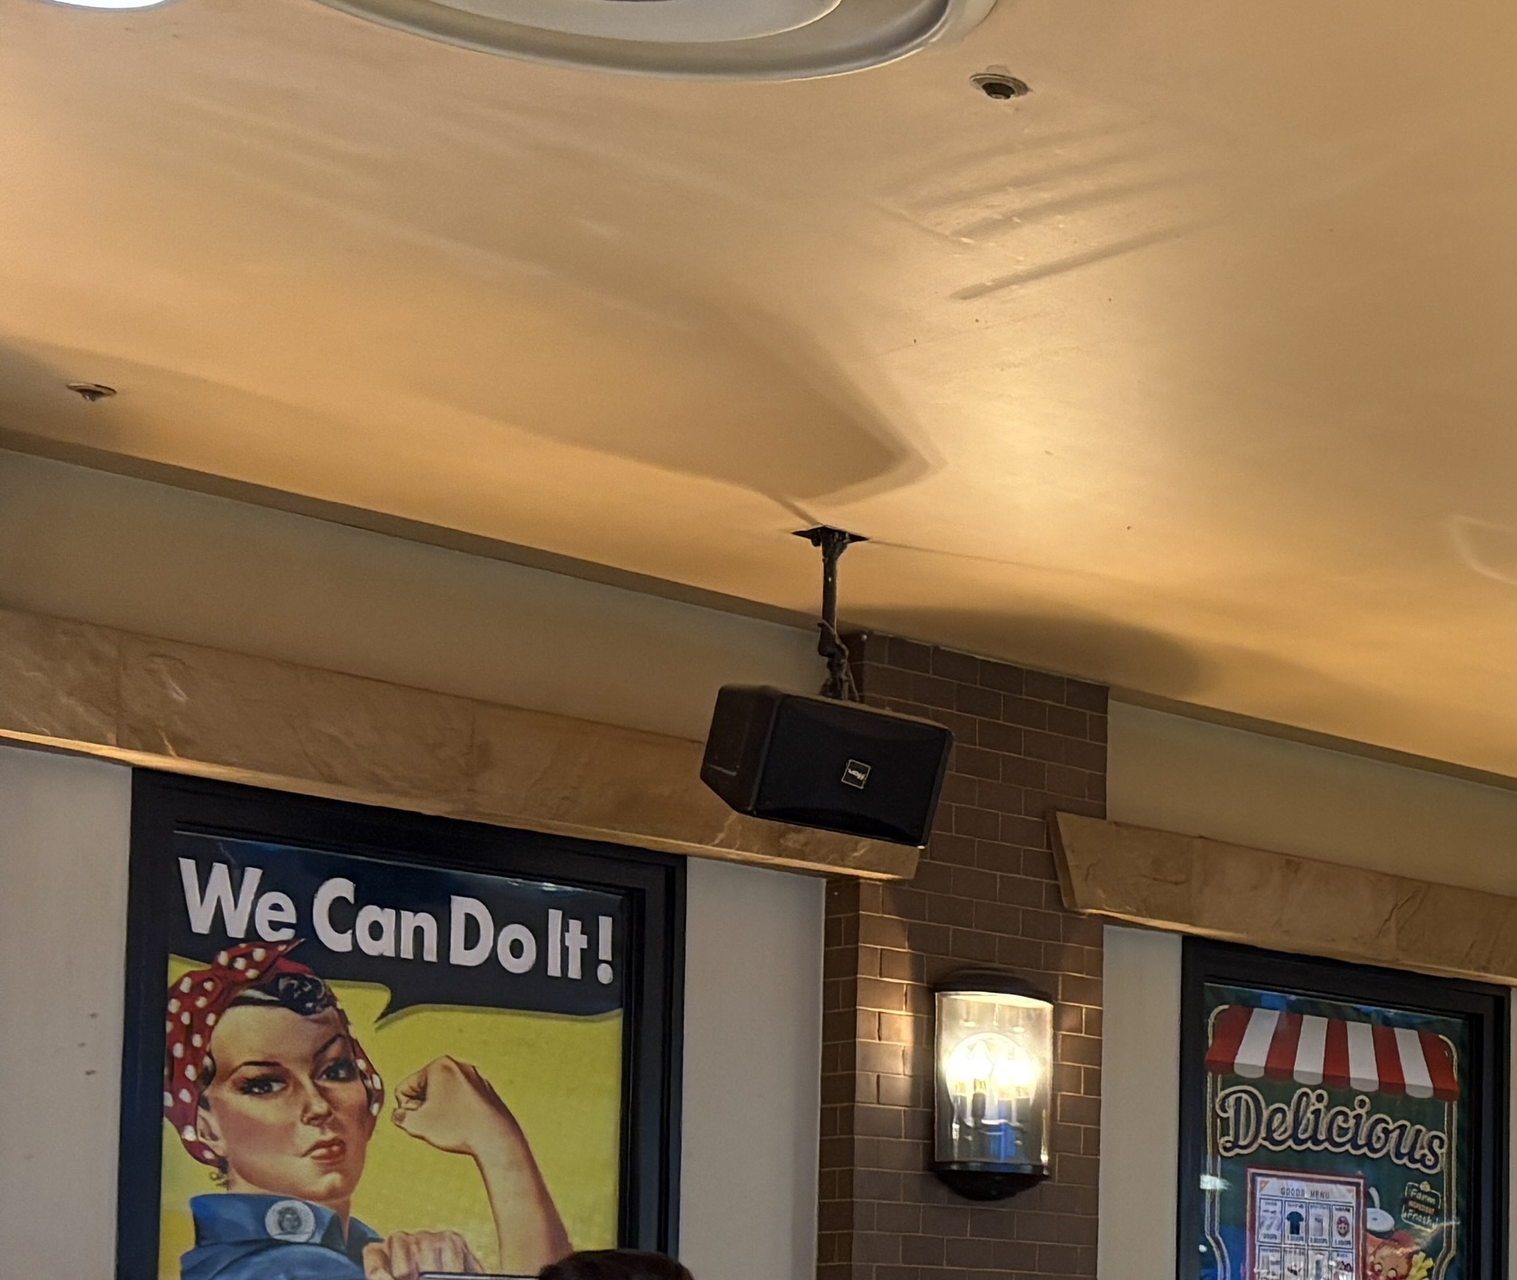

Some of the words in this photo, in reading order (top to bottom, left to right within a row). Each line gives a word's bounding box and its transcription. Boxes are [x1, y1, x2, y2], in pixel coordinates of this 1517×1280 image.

[178, 857, 298, 942] We
[312, 877, 438, 963] Can
[450, 895, 537, 974] Do
[547, 908, 613, 985] It!
[1216, 1086, 1448, 1174] Delicious
